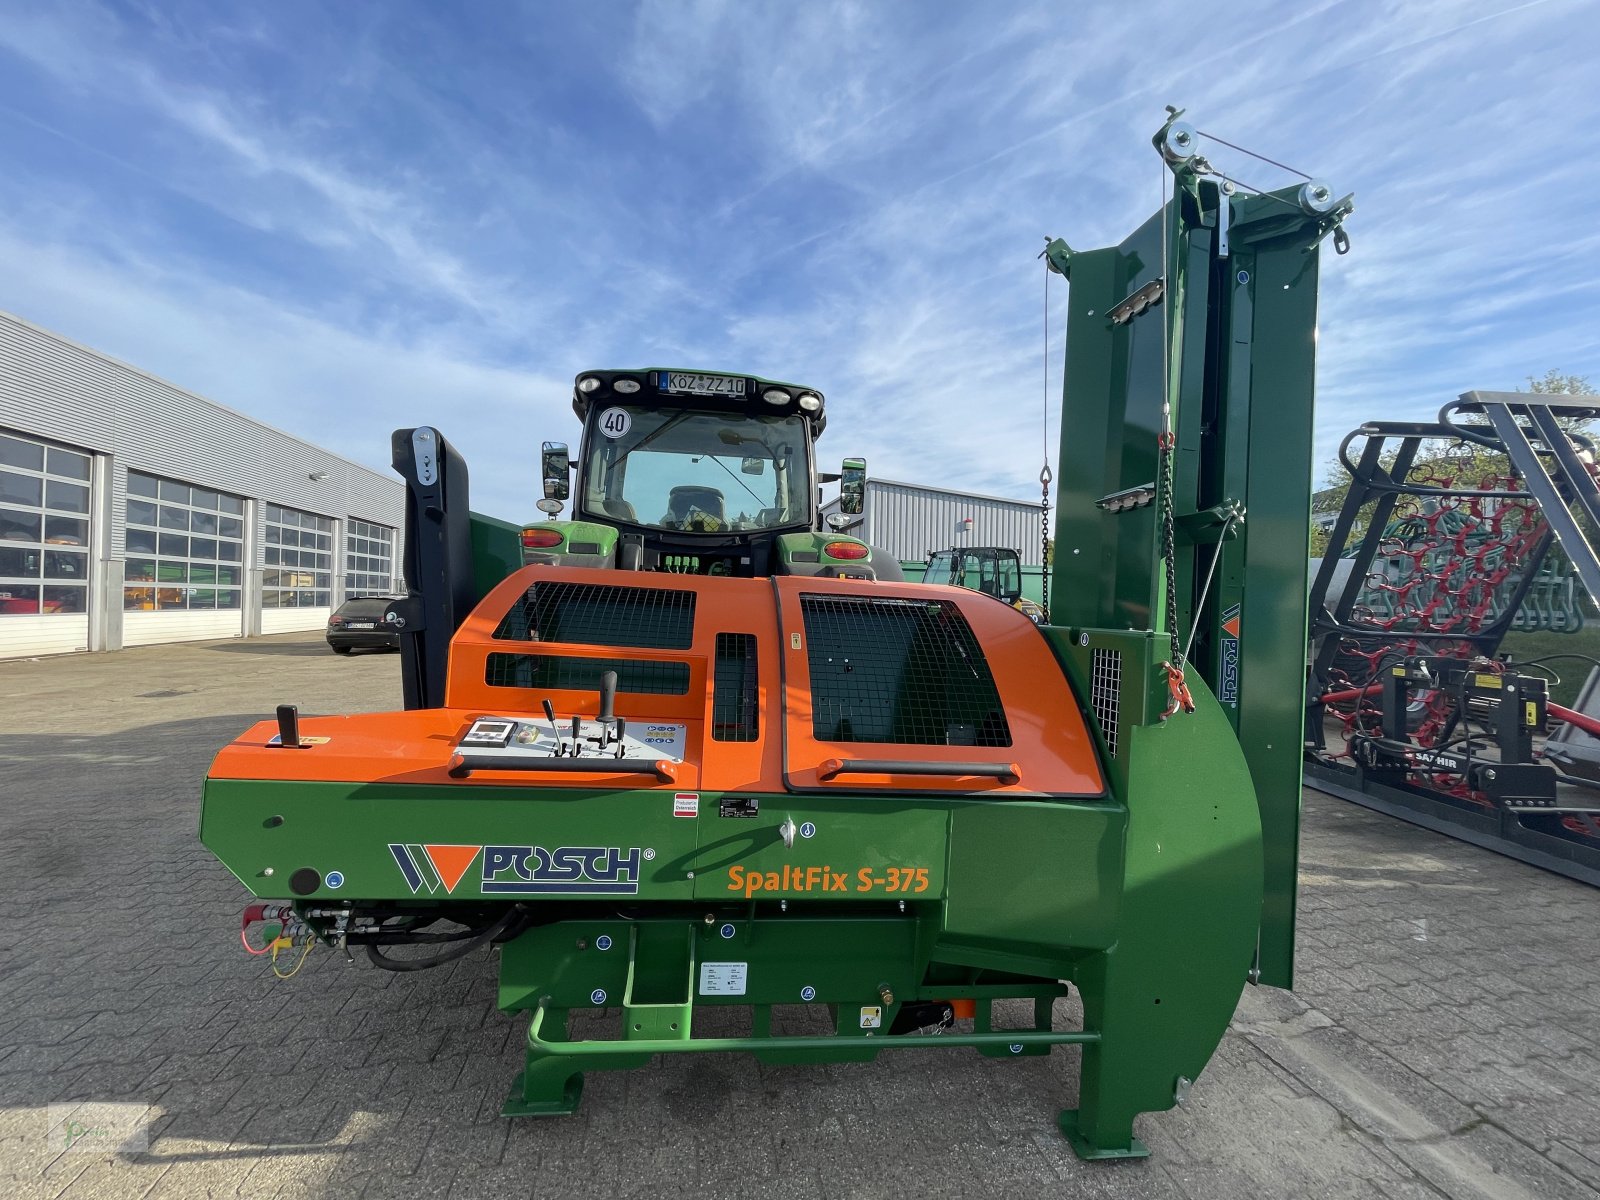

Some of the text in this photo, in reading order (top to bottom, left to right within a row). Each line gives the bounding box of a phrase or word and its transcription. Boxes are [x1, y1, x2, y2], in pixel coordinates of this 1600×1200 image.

[707, 377, 724, 392] ZZ
[727, 378, 744, 393] 10
[605, 413, 625, 432] 40
[728, 865, 929, 898] SpaltFix S-375
